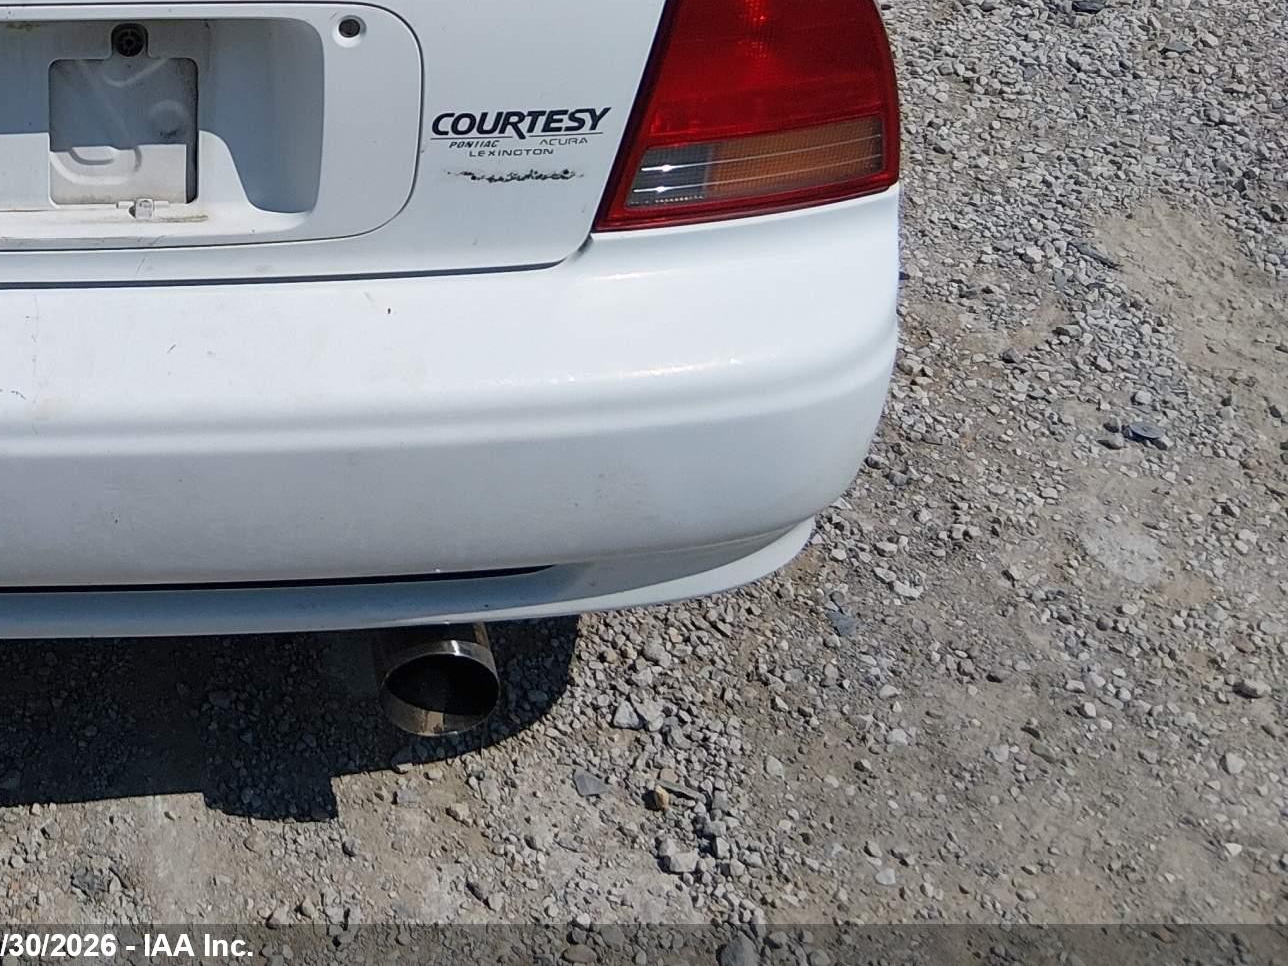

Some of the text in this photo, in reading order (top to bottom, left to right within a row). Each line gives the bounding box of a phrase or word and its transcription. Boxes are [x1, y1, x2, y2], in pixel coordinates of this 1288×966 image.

[431, 107, 612, 140] COURTESY
[448, 137, 589, 149] PONTIAC ACURA
[468, 148, 554, 157] LEXINGTON
